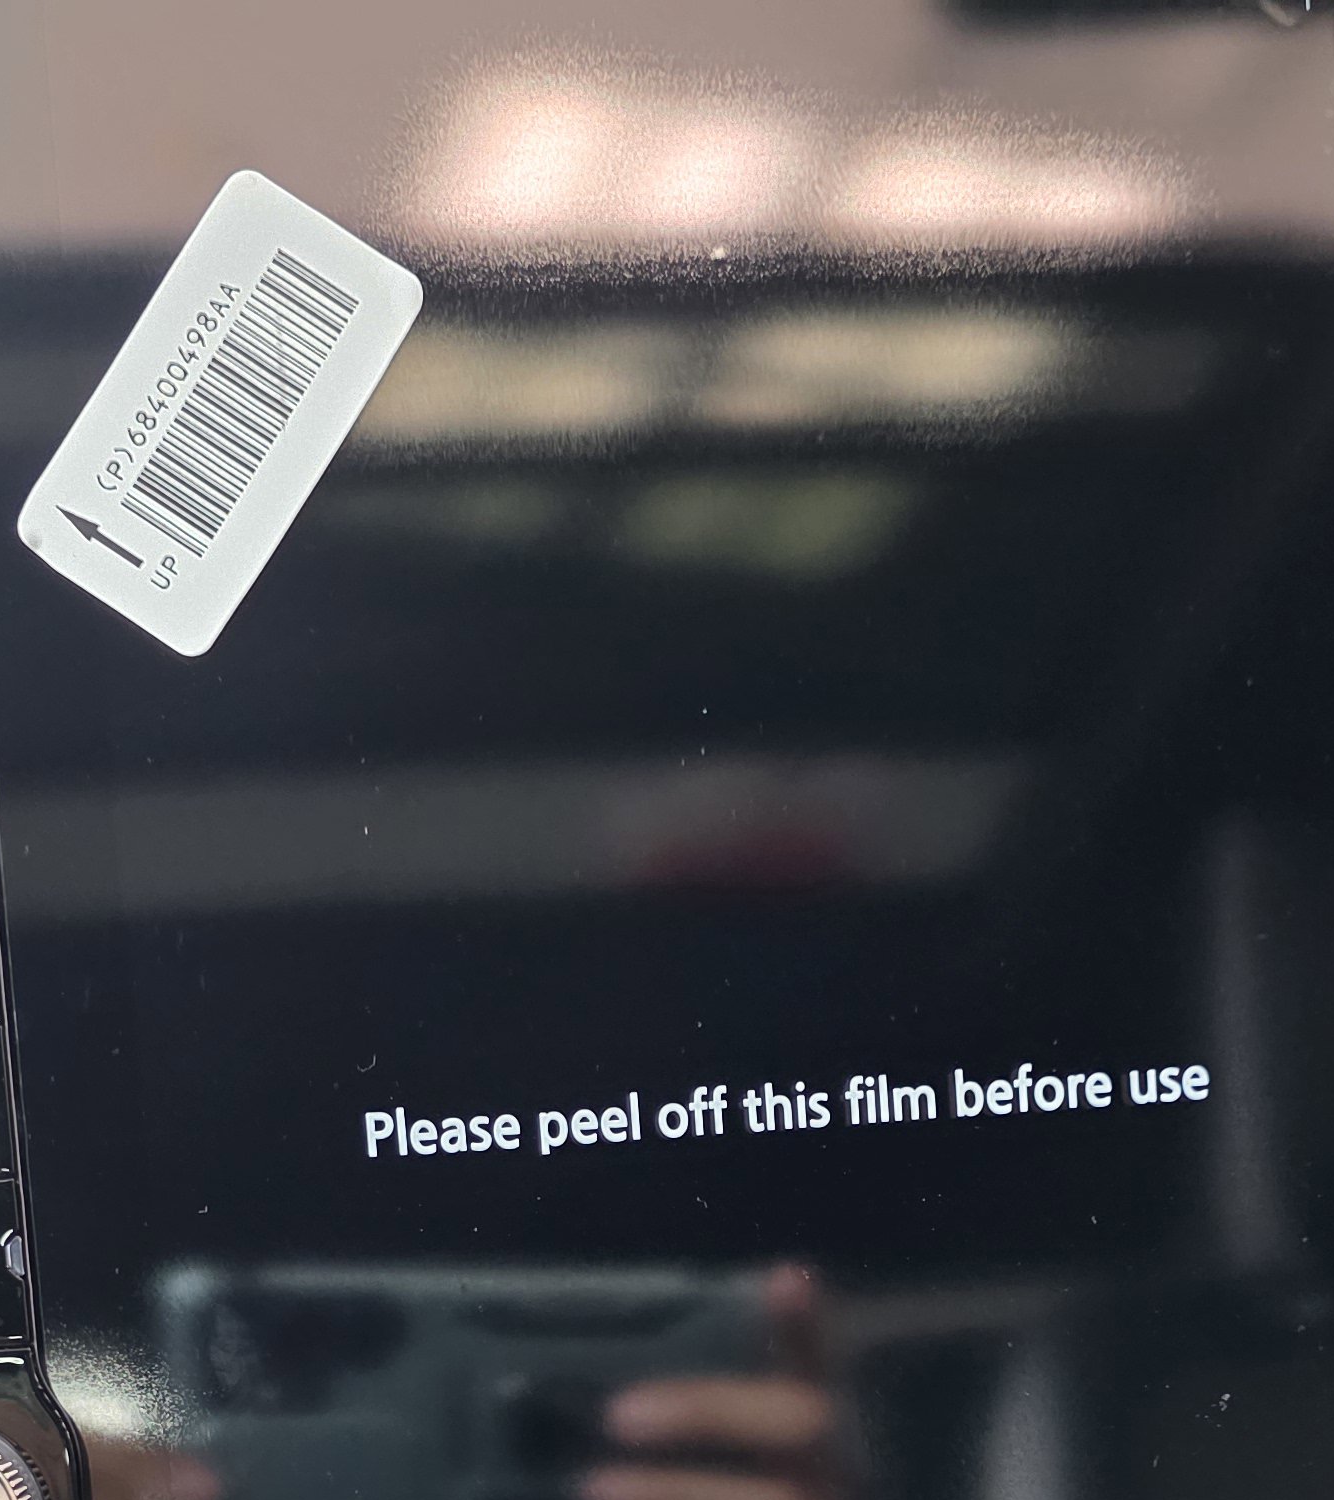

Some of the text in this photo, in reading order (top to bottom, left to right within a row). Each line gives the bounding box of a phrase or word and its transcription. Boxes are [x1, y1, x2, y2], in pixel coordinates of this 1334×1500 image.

[97, 282, 241, 491] (P)68400498AA
[150, 555, 179, 590] UP
[364, 1062, 1210, 1159] Please peel off this film before use
